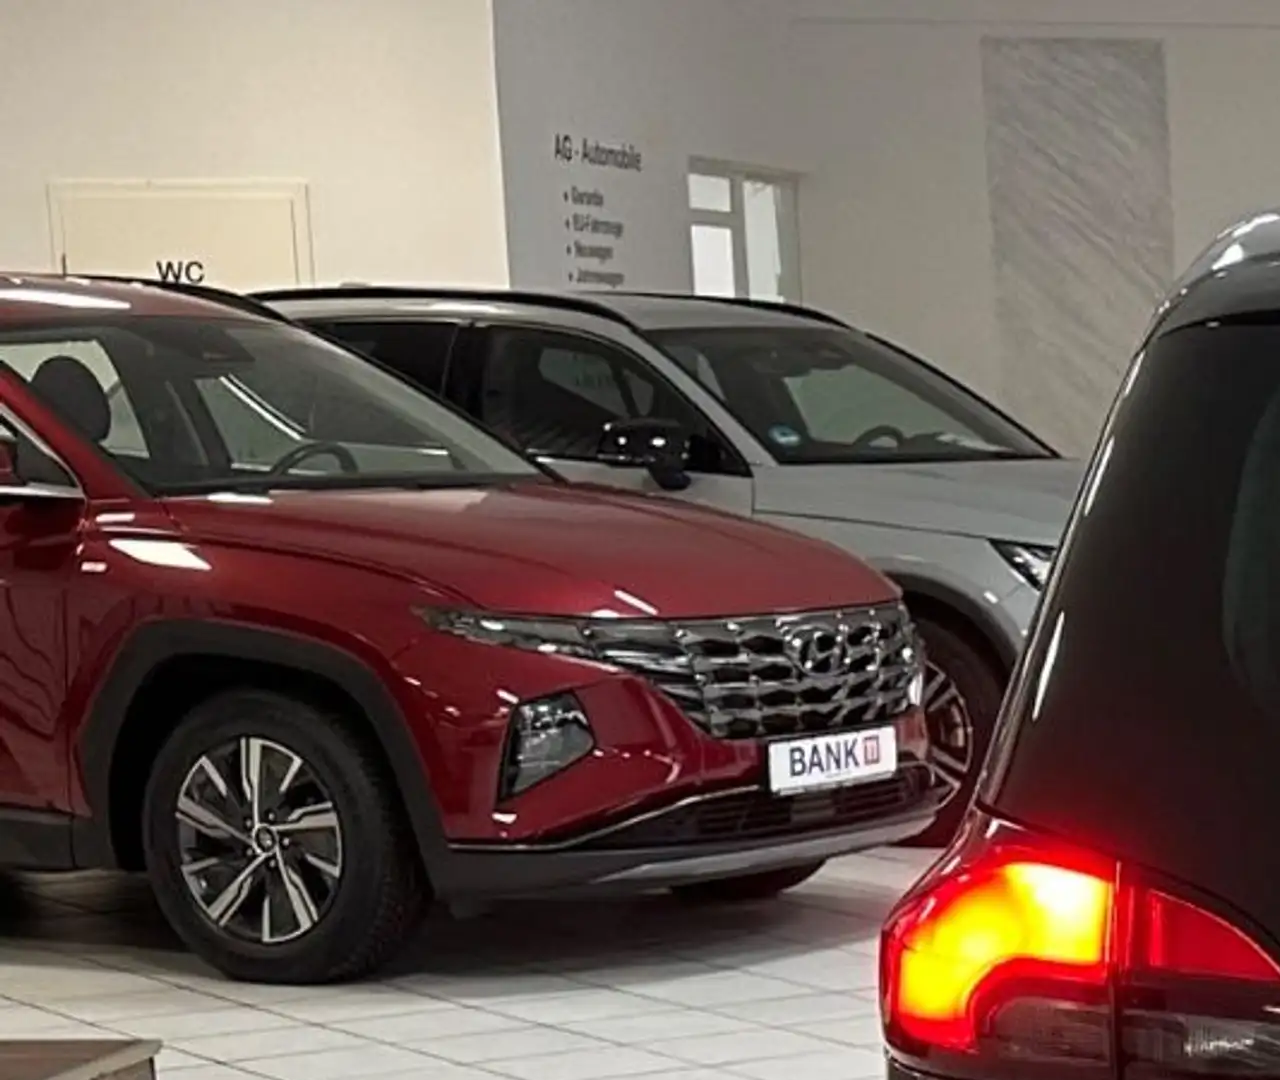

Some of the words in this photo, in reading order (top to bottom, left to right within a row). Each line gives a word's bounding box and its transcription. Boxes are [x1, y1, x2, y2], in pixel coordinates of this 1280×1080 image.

[554, 132, 573, 163] AG
[156, 260, 205, 285] WC
[789, 738, 860, 777] BANK
